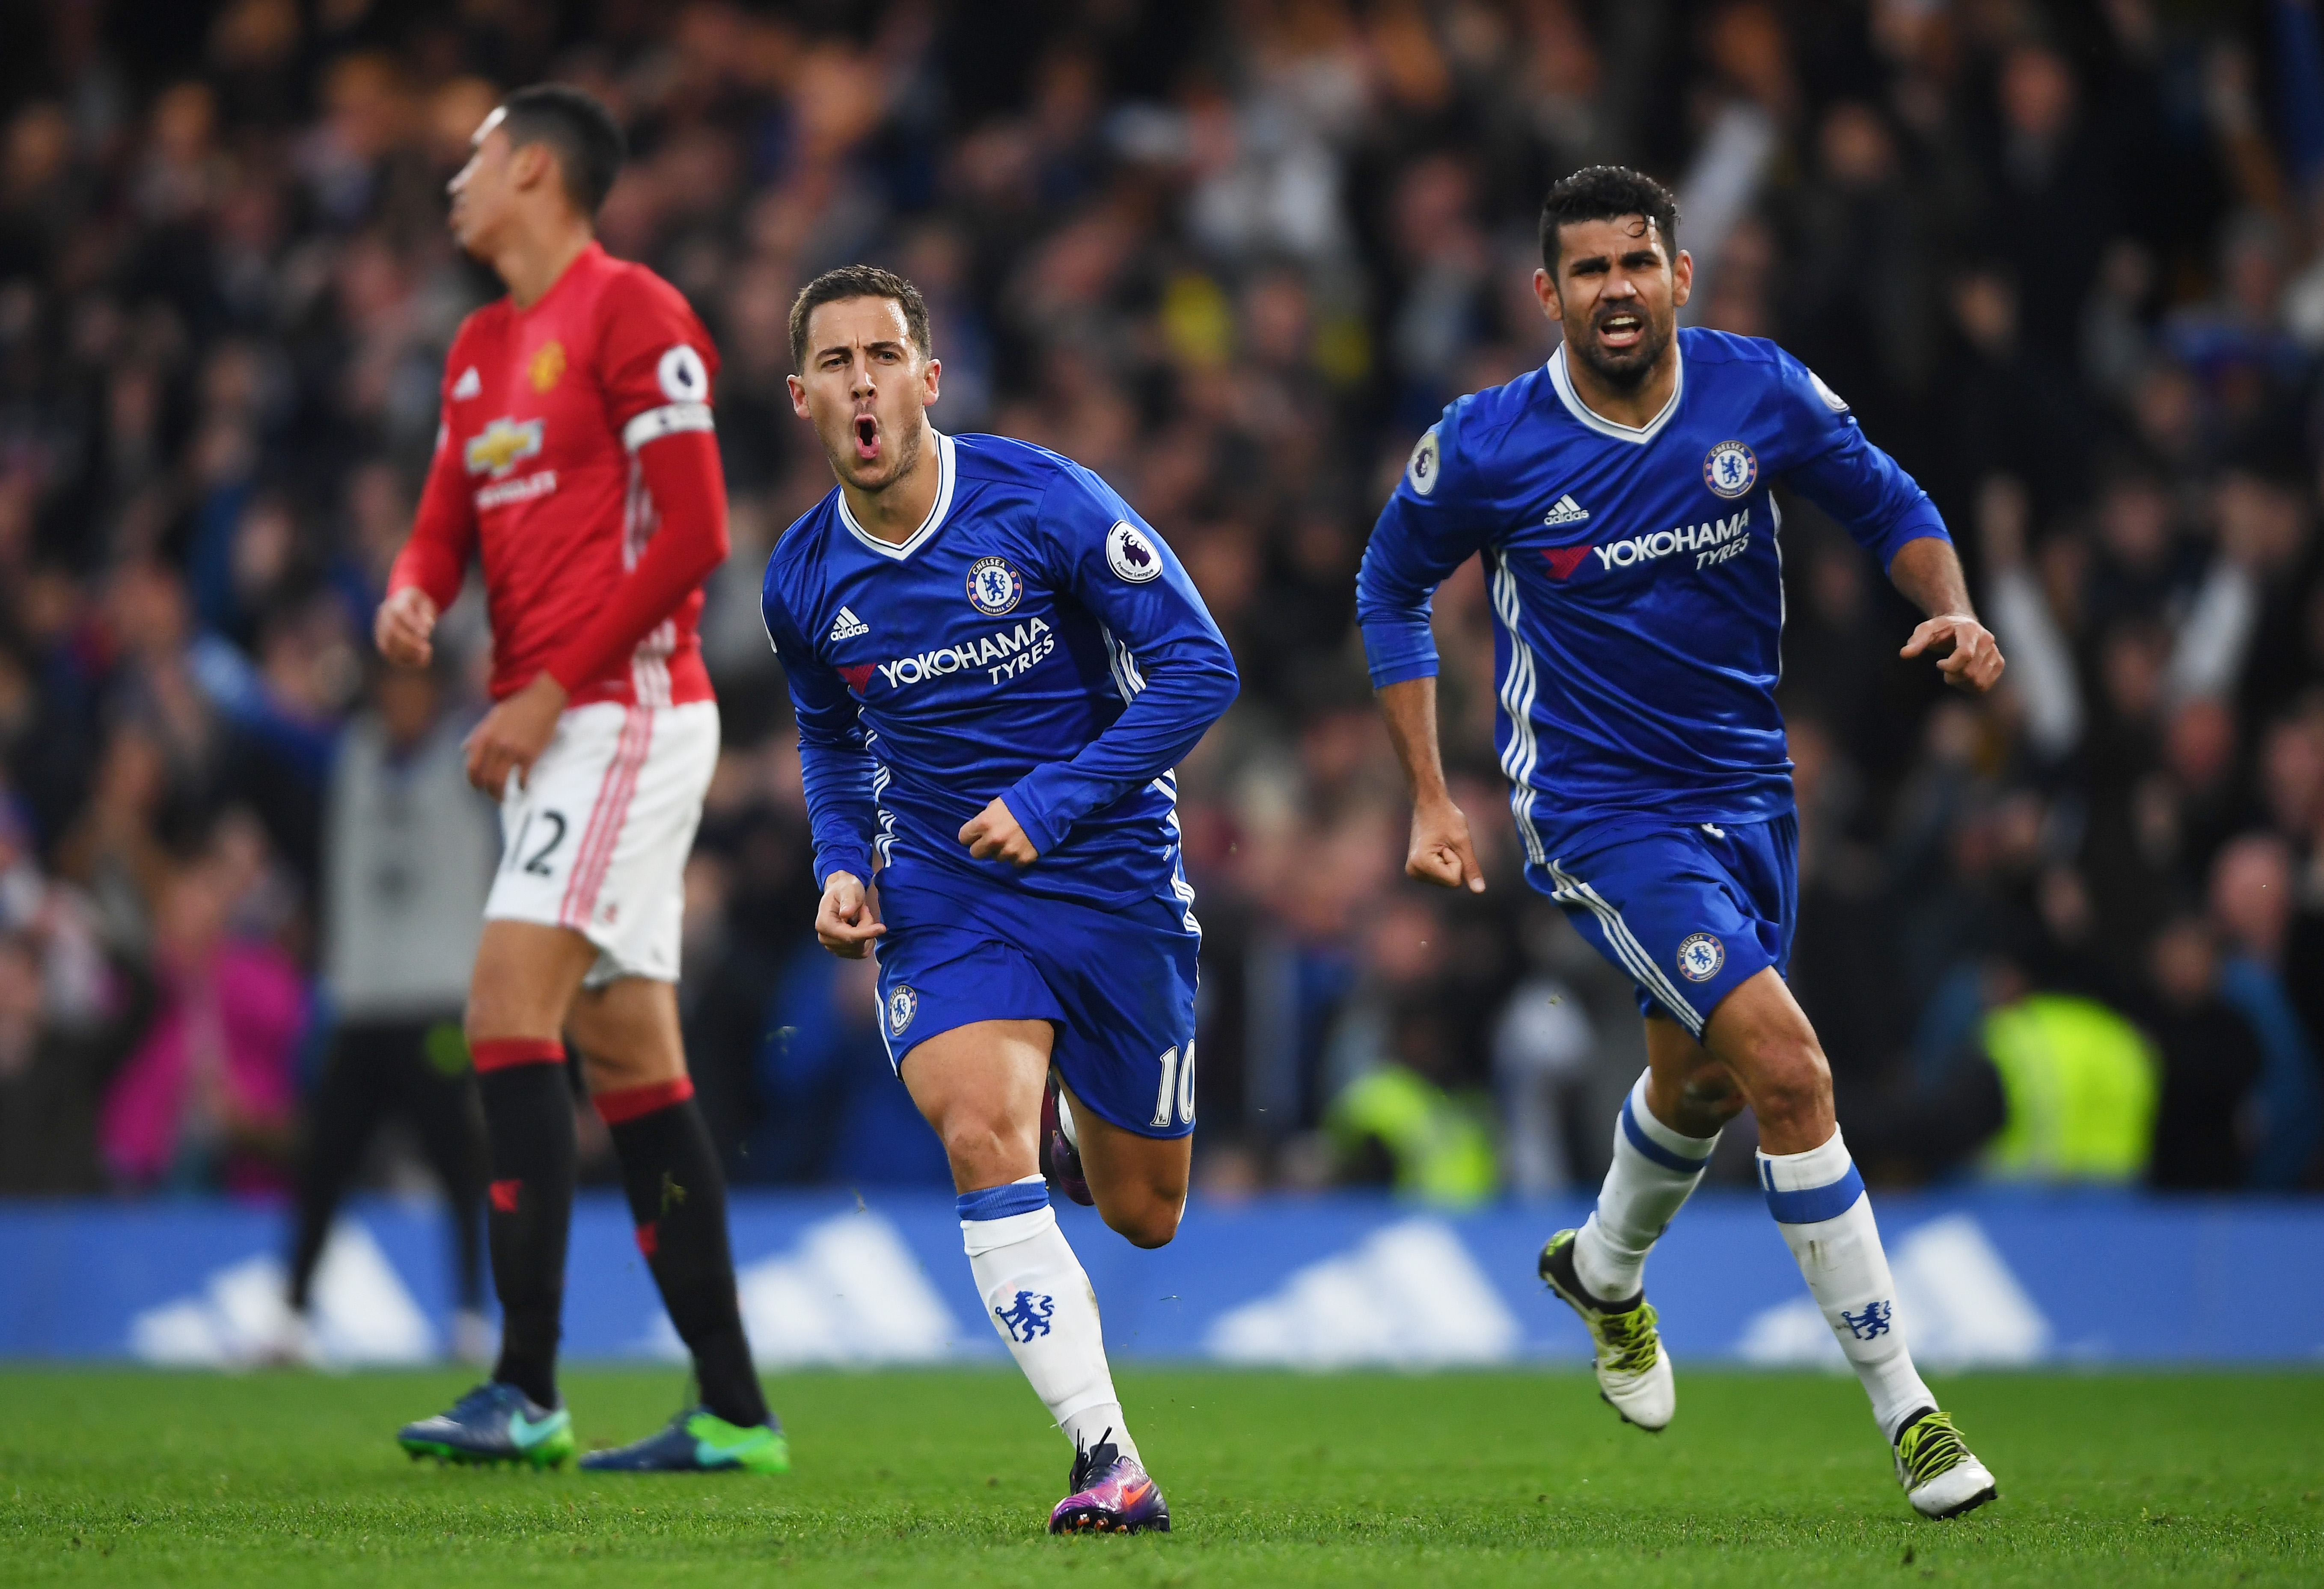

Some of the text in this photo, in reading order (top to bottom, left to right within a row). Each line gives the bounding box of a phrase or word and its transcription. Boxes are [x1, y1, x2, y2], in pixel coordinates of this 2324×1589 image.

[1711, 443, 1745, 457] CHELSEA
[1544, 510, 1589, 525] adidas
[1593, 508, 1749, 570] YOKOHAMA
[1696, 532, 1750, 570] TYRES
[972, 559, 1005, 575] CHELSEA
[1116, 561, 1153, 577] Premier League
[1006, 596, 1017, 608] CLUB
[830, 623, 869, 641] adidas
[877, 617, 1050, 688] YOKOHAMA
[988, 633, 1055, 685] TYRES
[1150, 1039, 1195, 1127] 10
